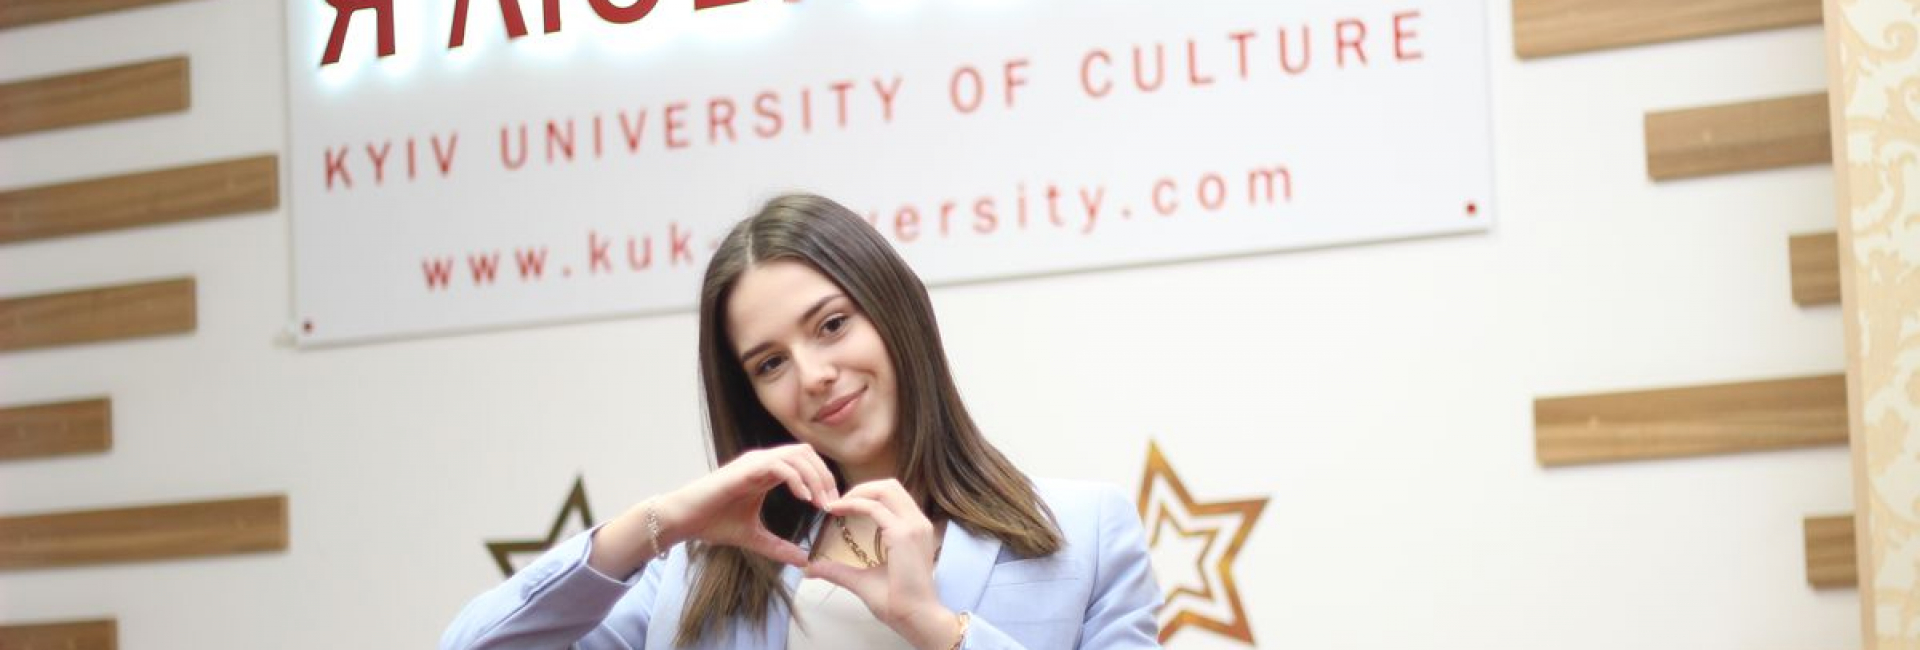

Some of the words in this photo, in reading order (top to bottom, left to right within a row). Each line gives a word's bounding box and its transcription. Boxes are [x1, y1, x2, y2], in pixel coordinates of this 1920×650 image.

[323, 132, 458, 191] KYIV
[499, 80, 901, 172] UNIVERSITY
[949, 57, 1029, 115] OF
[1080, 10, 1424, 100] CULTURE
